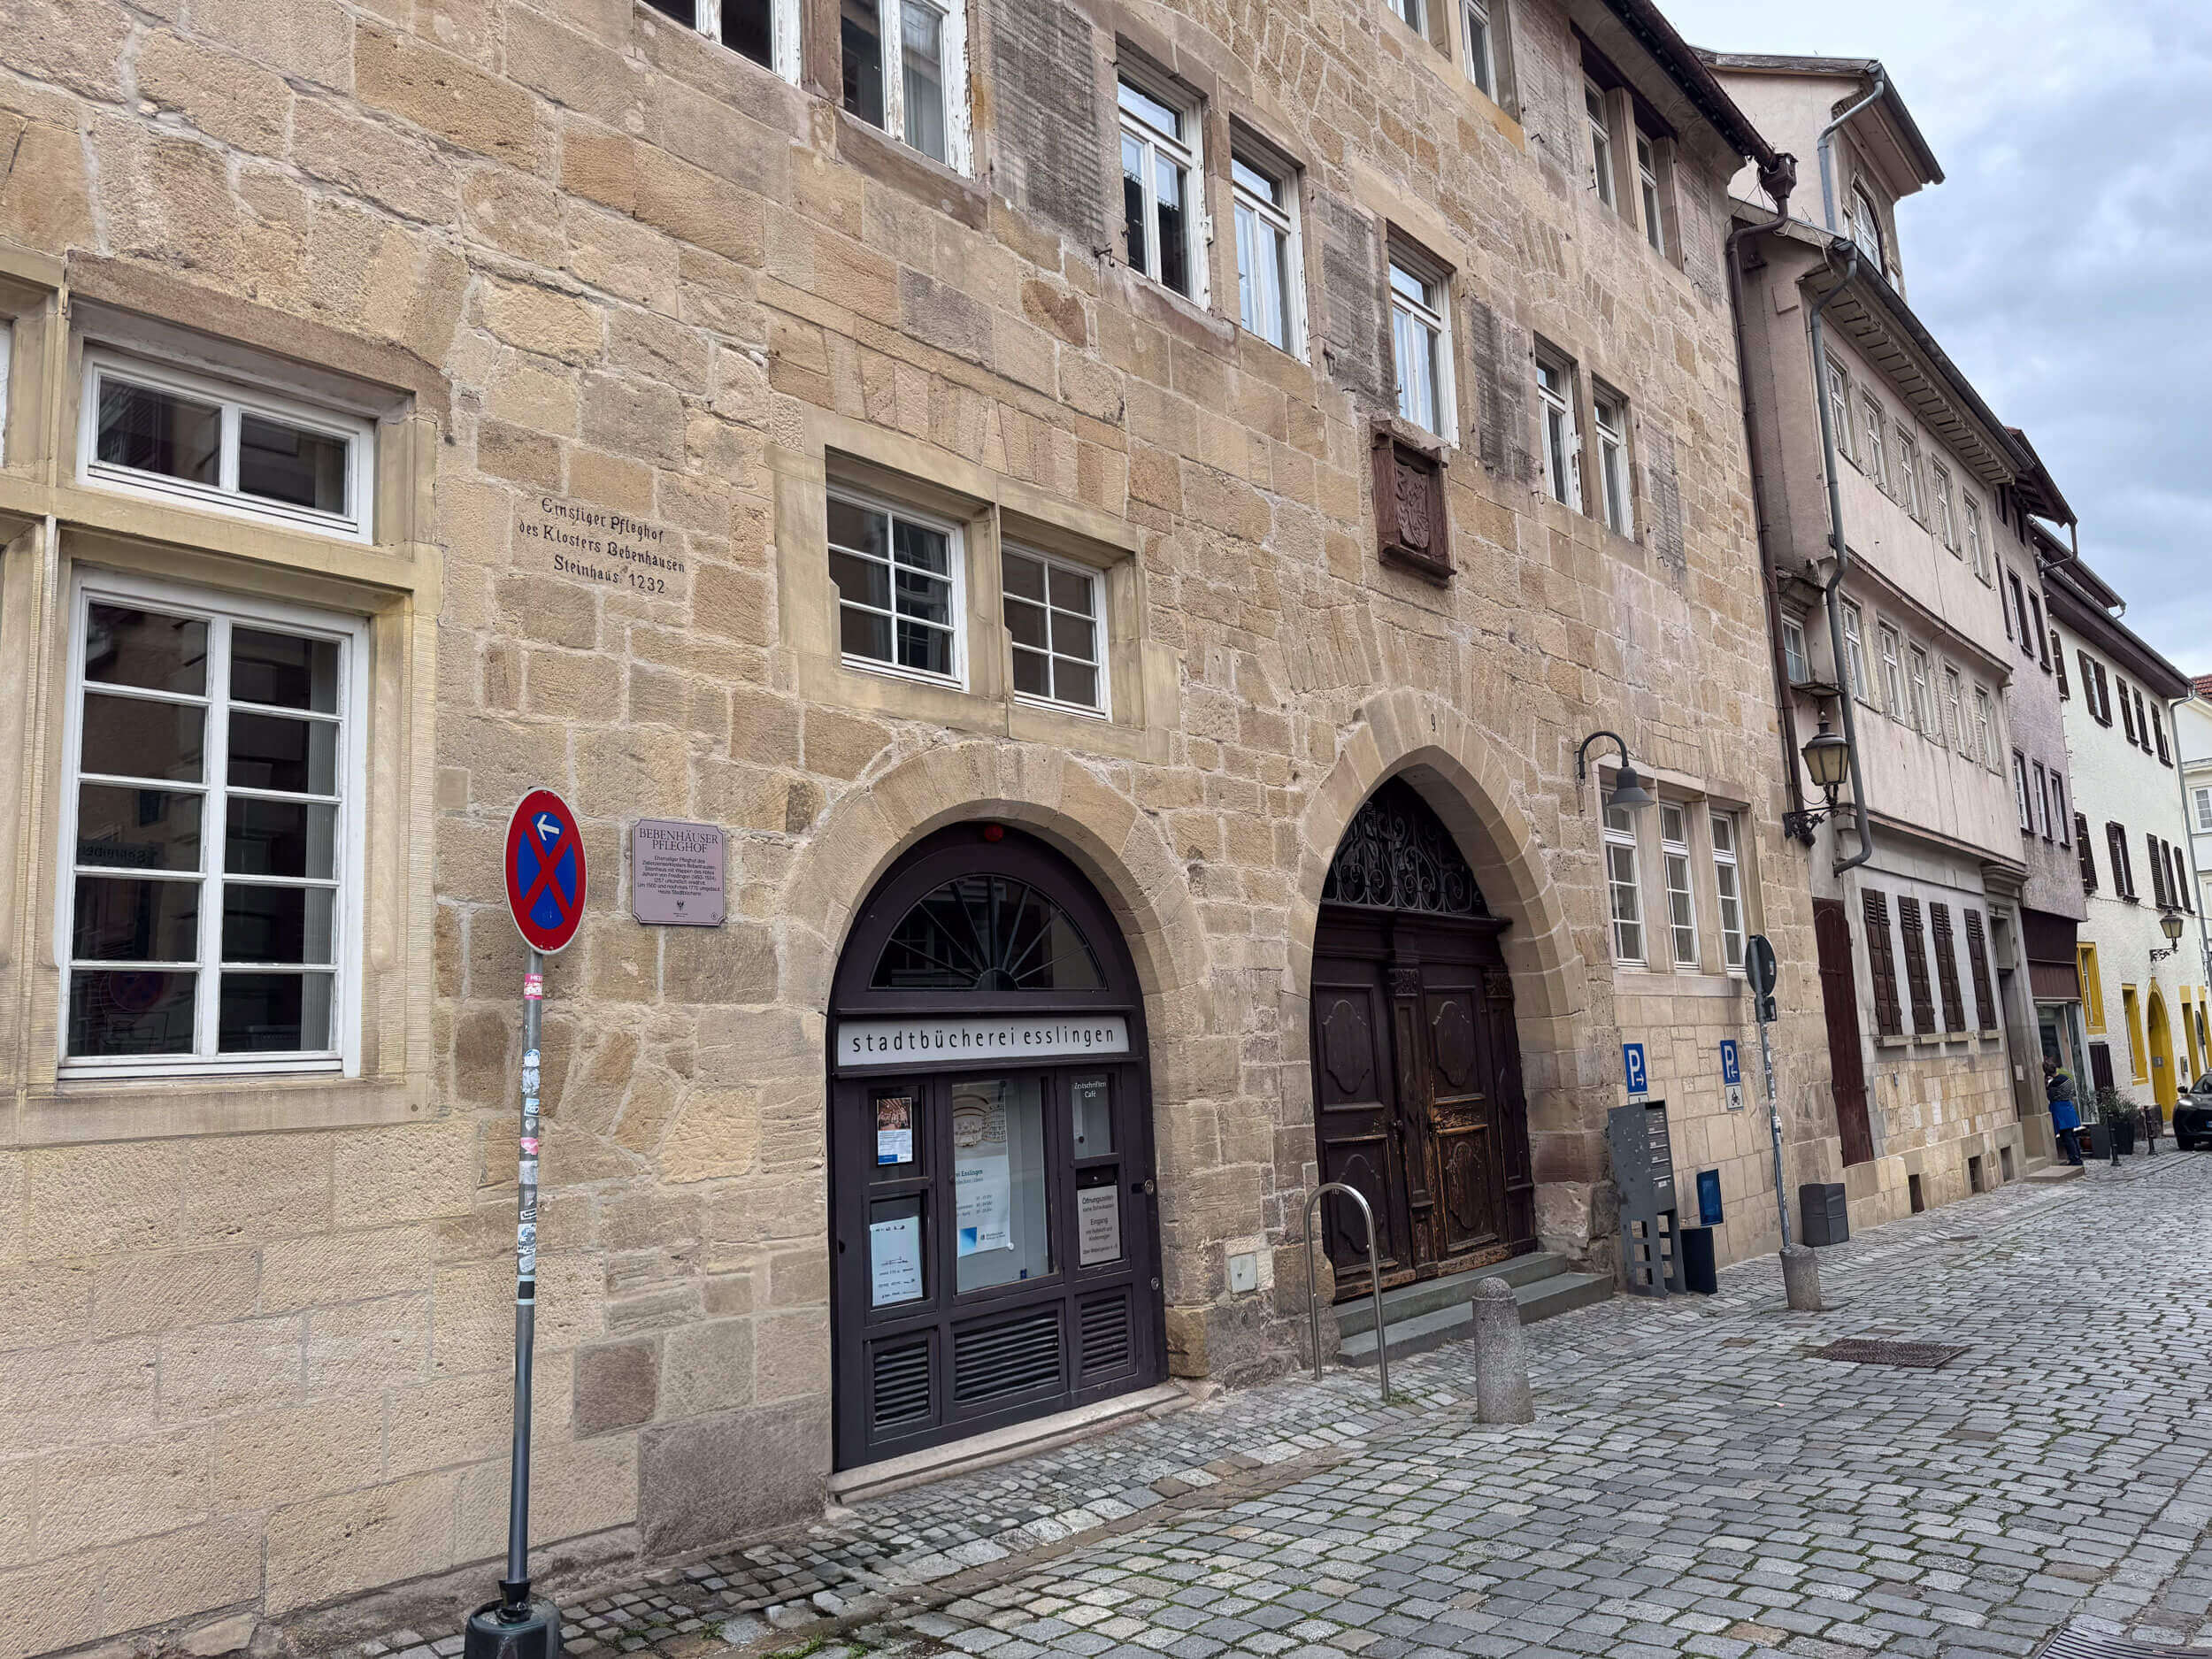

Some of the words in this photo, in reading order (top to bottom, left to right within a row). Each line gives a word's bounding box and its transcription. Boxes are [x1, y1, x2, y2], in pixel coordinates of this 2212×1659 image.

[611, 516, 664, 543] Pfleghof
[519, 519, 539, 537] des
[543, 525, 602, 553] Klosters
[607, 541, 685, 572] Bebenhausen
[554, 554, 619, 583] Steinhaus
[628, 572, 665, 594] 1232
[640, 827, 718, 844] BEBENHÄUSER
[651, 839, 708, 853] PFLEGHOF
[852, 1027, 1015, 1053] stadtbücherei
[1023, 1025, 1114, 1047] esslingen
[1628, 1048, 1640, 1087] P
[1724, 1045, 1734, 1079] P
